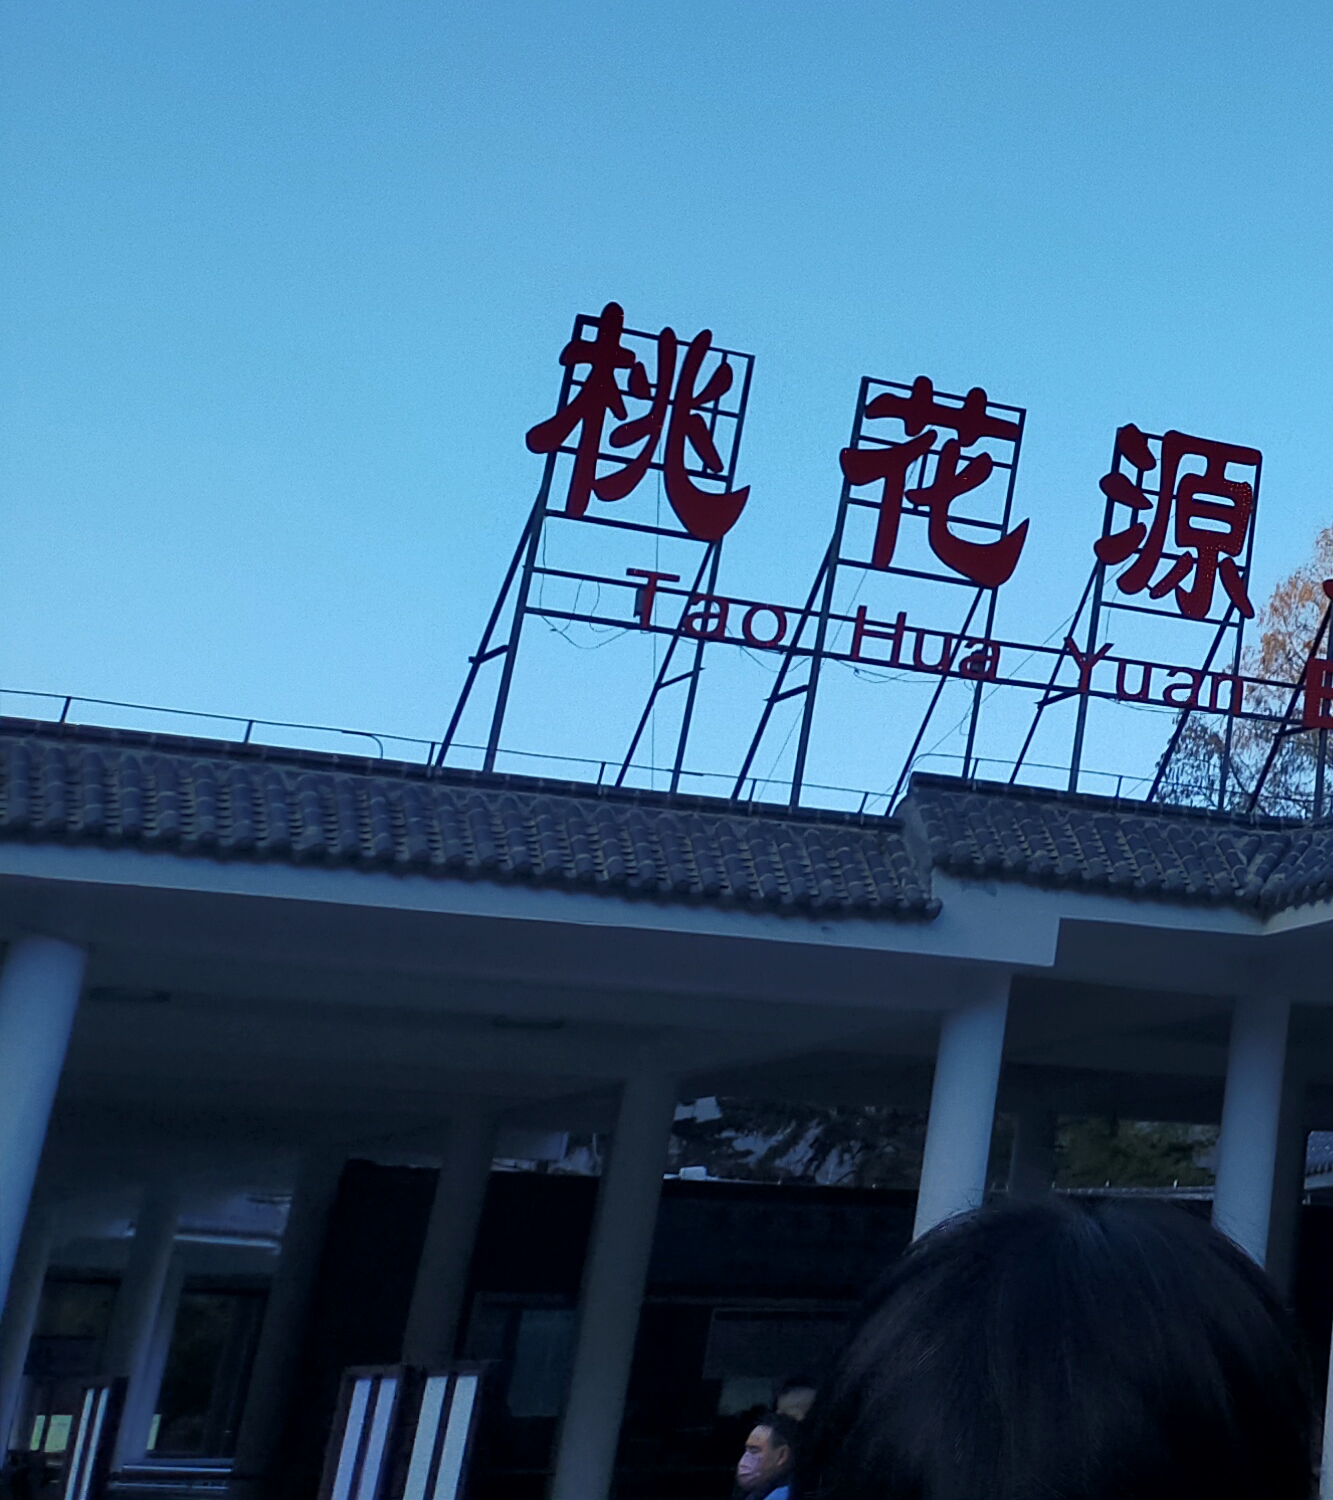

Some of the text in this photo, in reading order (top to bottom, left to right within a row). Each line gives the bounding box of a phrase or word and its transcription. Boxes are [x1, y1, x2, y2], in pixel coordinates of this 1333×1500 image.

[626, 567, 787, 649] Tao
[850, 605, 1002, 681] Hua
[1063, 636, 1244, 717] Yuan
